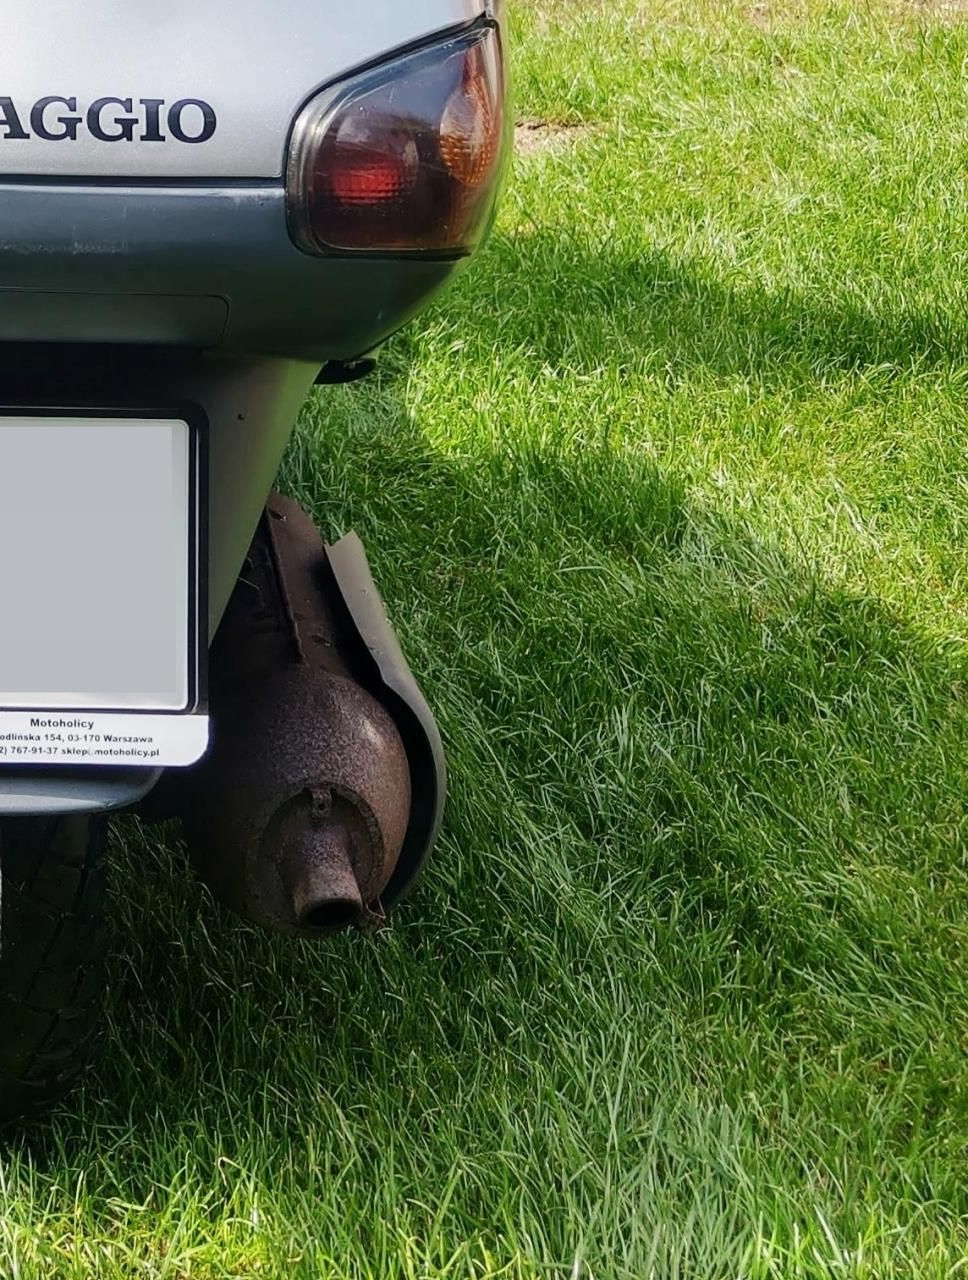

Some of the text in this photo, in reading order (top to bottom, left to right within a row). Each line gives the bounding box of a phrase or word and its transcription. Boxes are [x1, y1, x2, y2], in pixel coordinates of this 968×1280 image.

[29, 717, 95, 730] Motoholicy
[44, 733, 65, 743] 154,
[103, 734, 153, 744] Warszawa
[10, 746, 59, 756] 767-91-37
